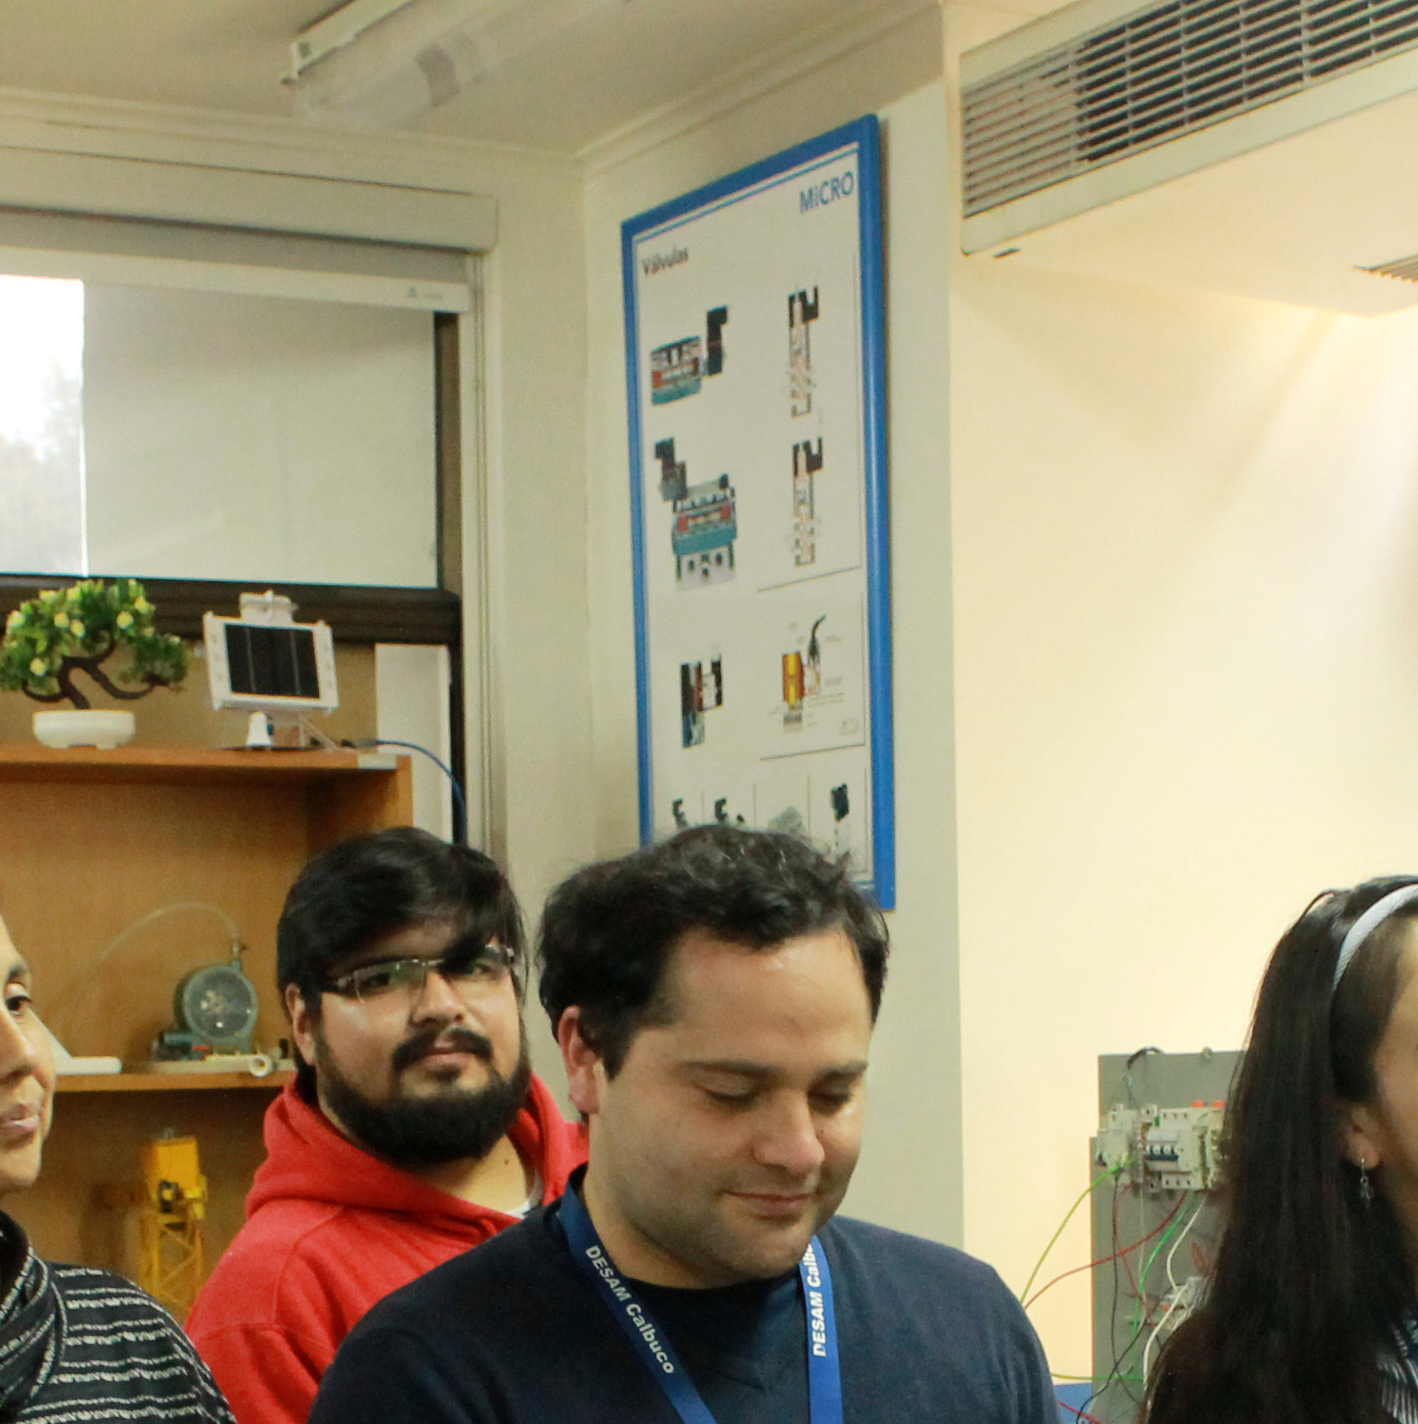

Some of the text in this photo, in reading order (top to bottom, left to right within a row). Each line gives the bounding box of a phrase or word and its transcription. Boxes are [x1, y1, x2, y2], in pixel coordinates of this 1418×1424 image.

[585, 1245, 675, 1374] DESAM Calbuco
[808, 1290, 828, 1358] DESAM
